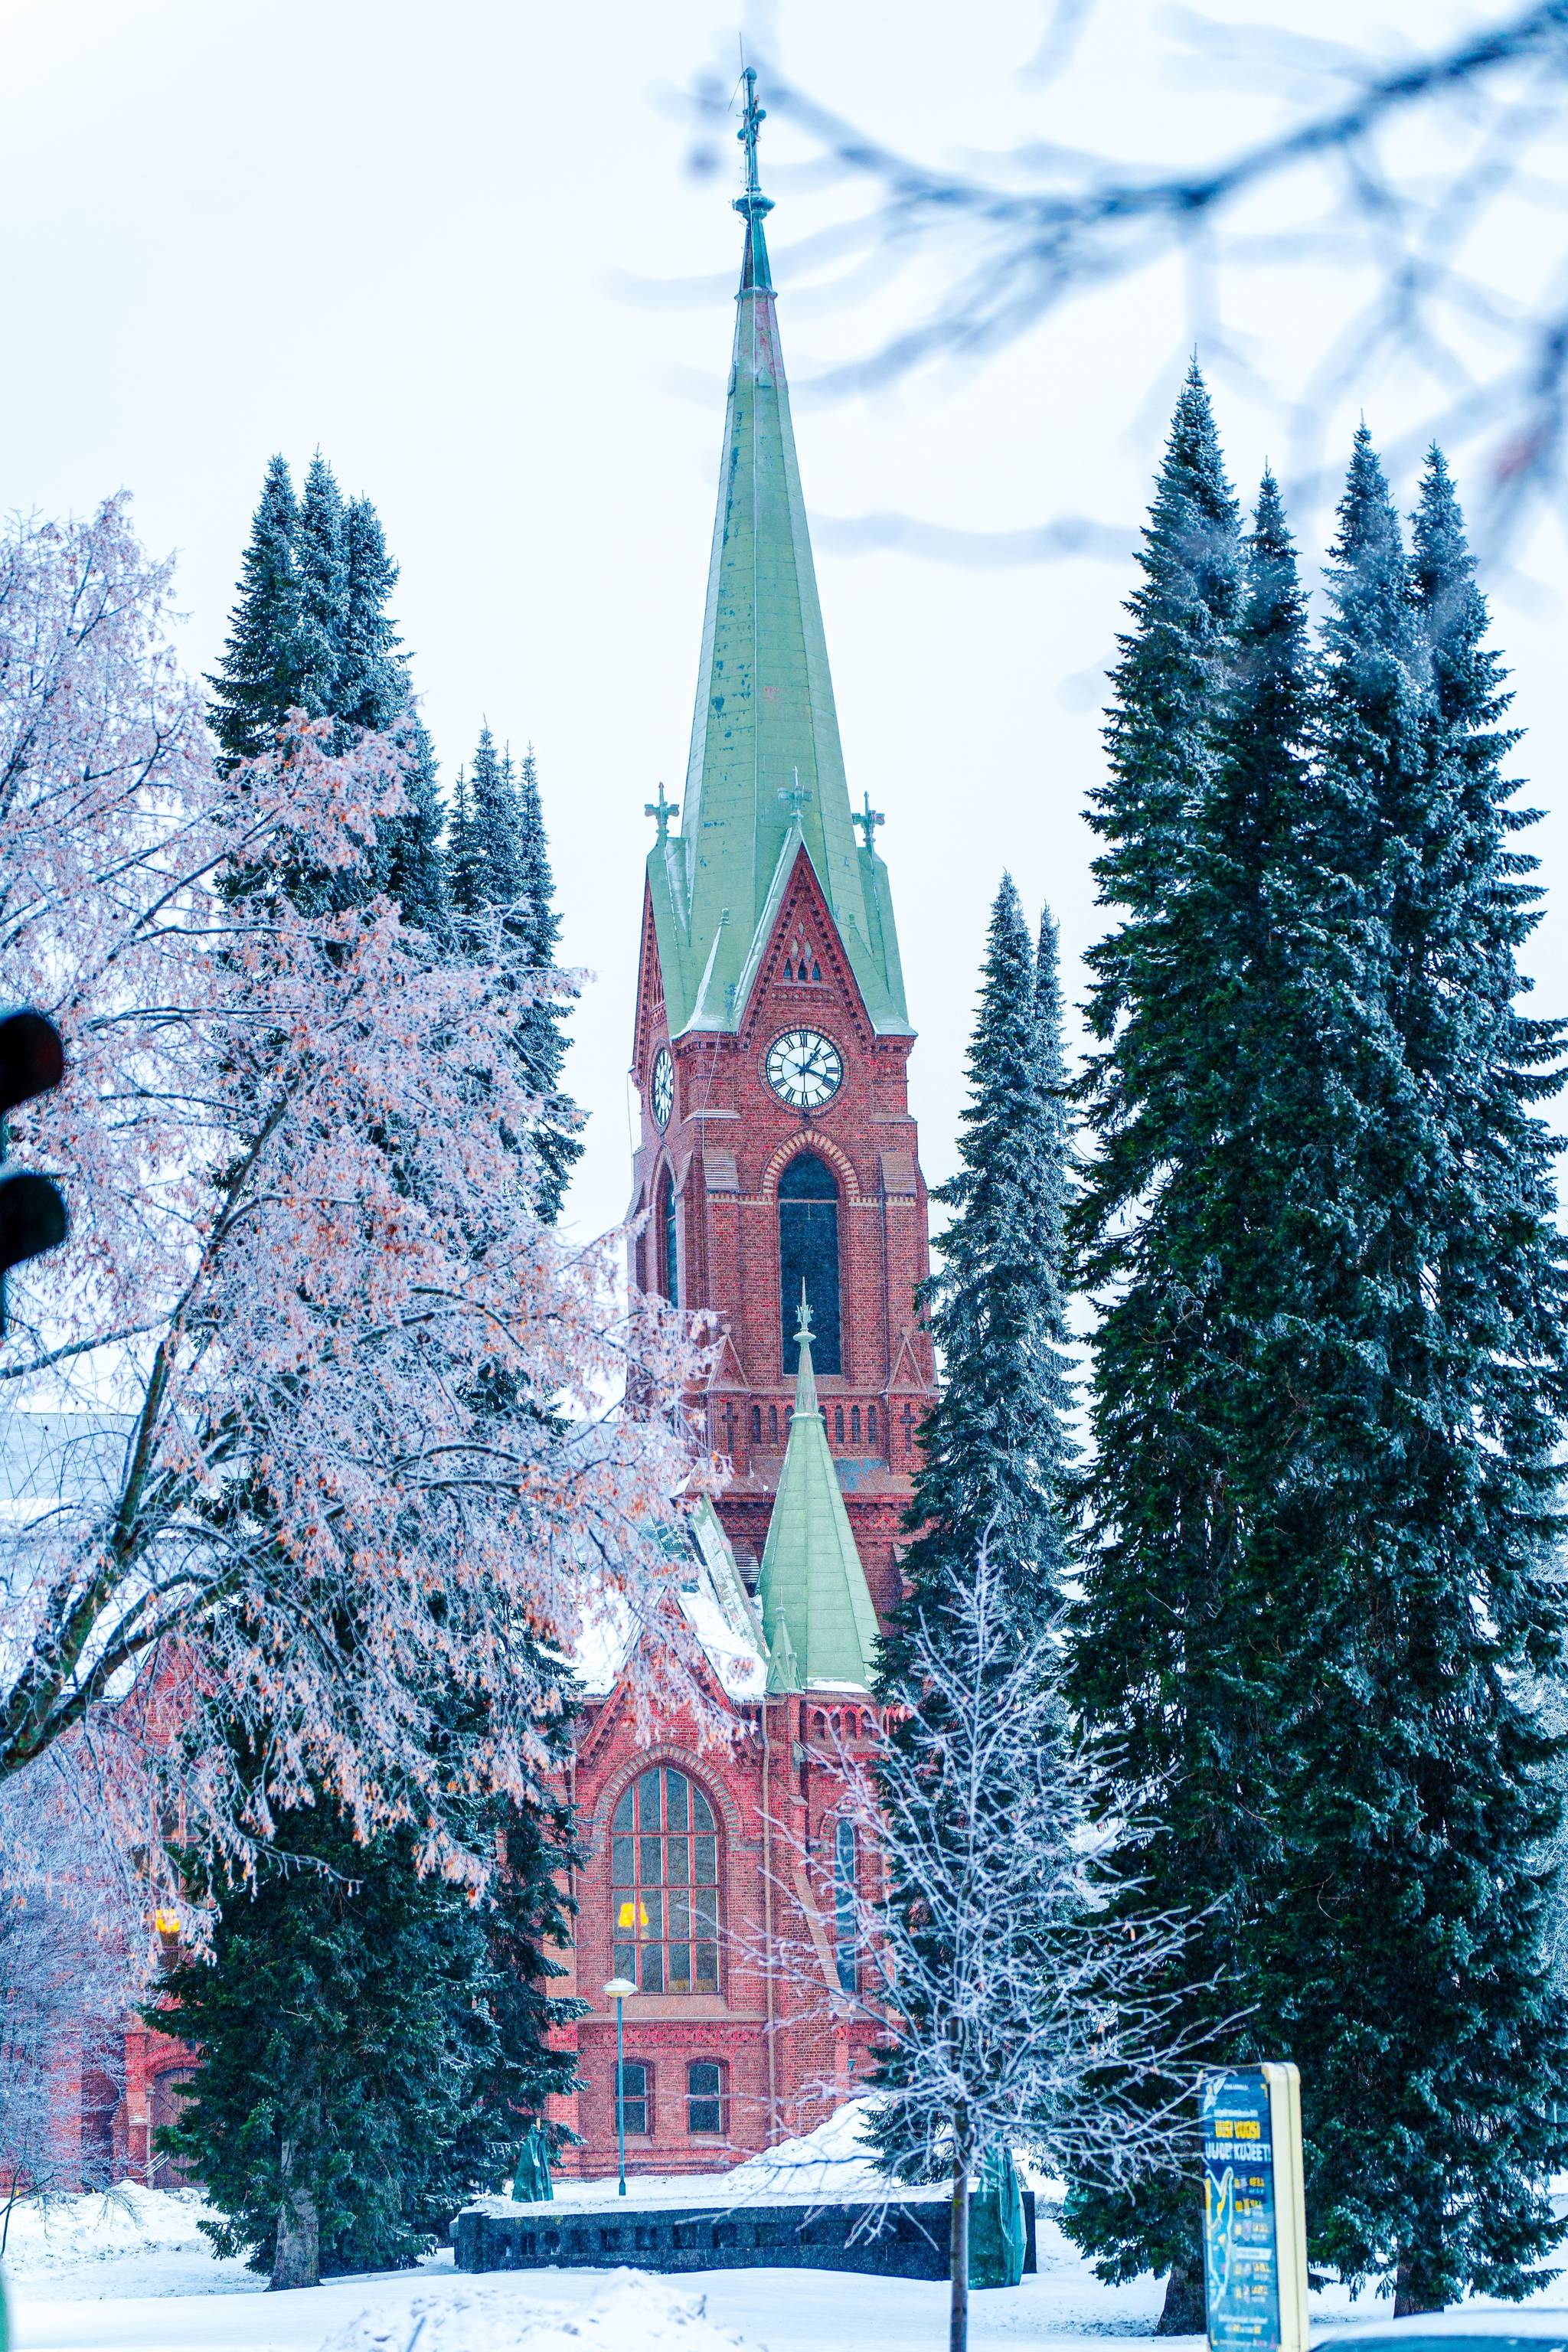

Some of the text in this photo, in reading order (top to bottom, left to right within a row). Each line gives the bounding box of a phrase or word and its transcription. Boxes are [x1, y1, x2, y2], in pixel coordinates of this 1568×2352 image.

[783, 1037, 795, 1051] XI
[799, 1034, 808, 1047] XII
[772, 1048, 786, 1060] X
[822, 1050, 835, 1061] II
[801, 1092, 808, 1105] VI
[815, 1089, 825, 1102] V
